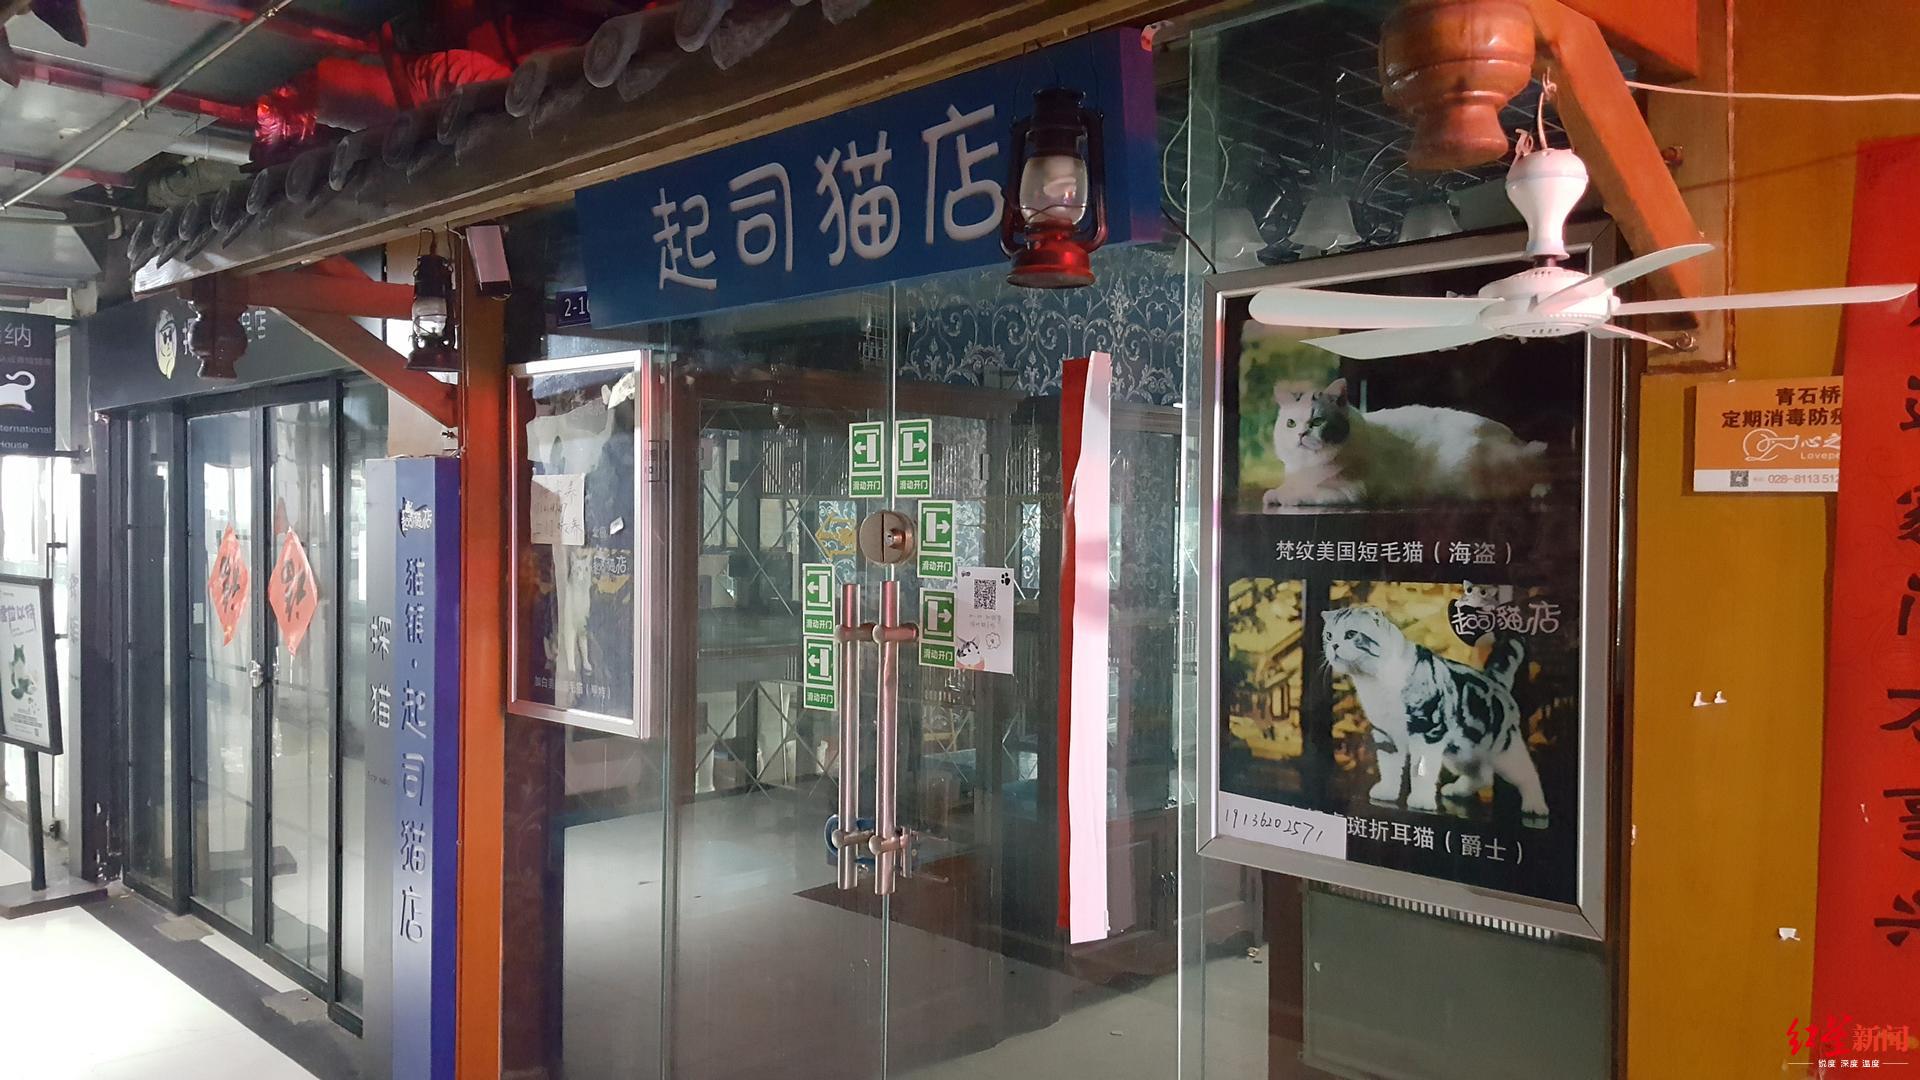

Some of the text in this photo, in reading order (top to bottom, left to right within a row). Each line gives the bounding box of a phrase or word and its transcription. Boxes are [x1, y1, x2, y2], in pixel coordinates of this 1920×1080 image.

[652, 103, 1004, 290] 起司猫店
[564, 296, 590, 317] 2-1
[0, 322, 32, 348] 纳
[1775, 385, 1841, 406] 青石桥
[852, 479, 881, 492] 滑动开门
[899, 479, 929, 491] 滑动开门
[921, 561, 952, 572] 滑动开门
[805, 619, 833, 630] 滑动开门
[923, 649, 953, 661] 滑动开门
[370, 616, 392, 728] 探猫
[806, 693, 834, 705] 滑动开门
[1346, 814, 1525, 865] 斑折耳猫（爵士）
